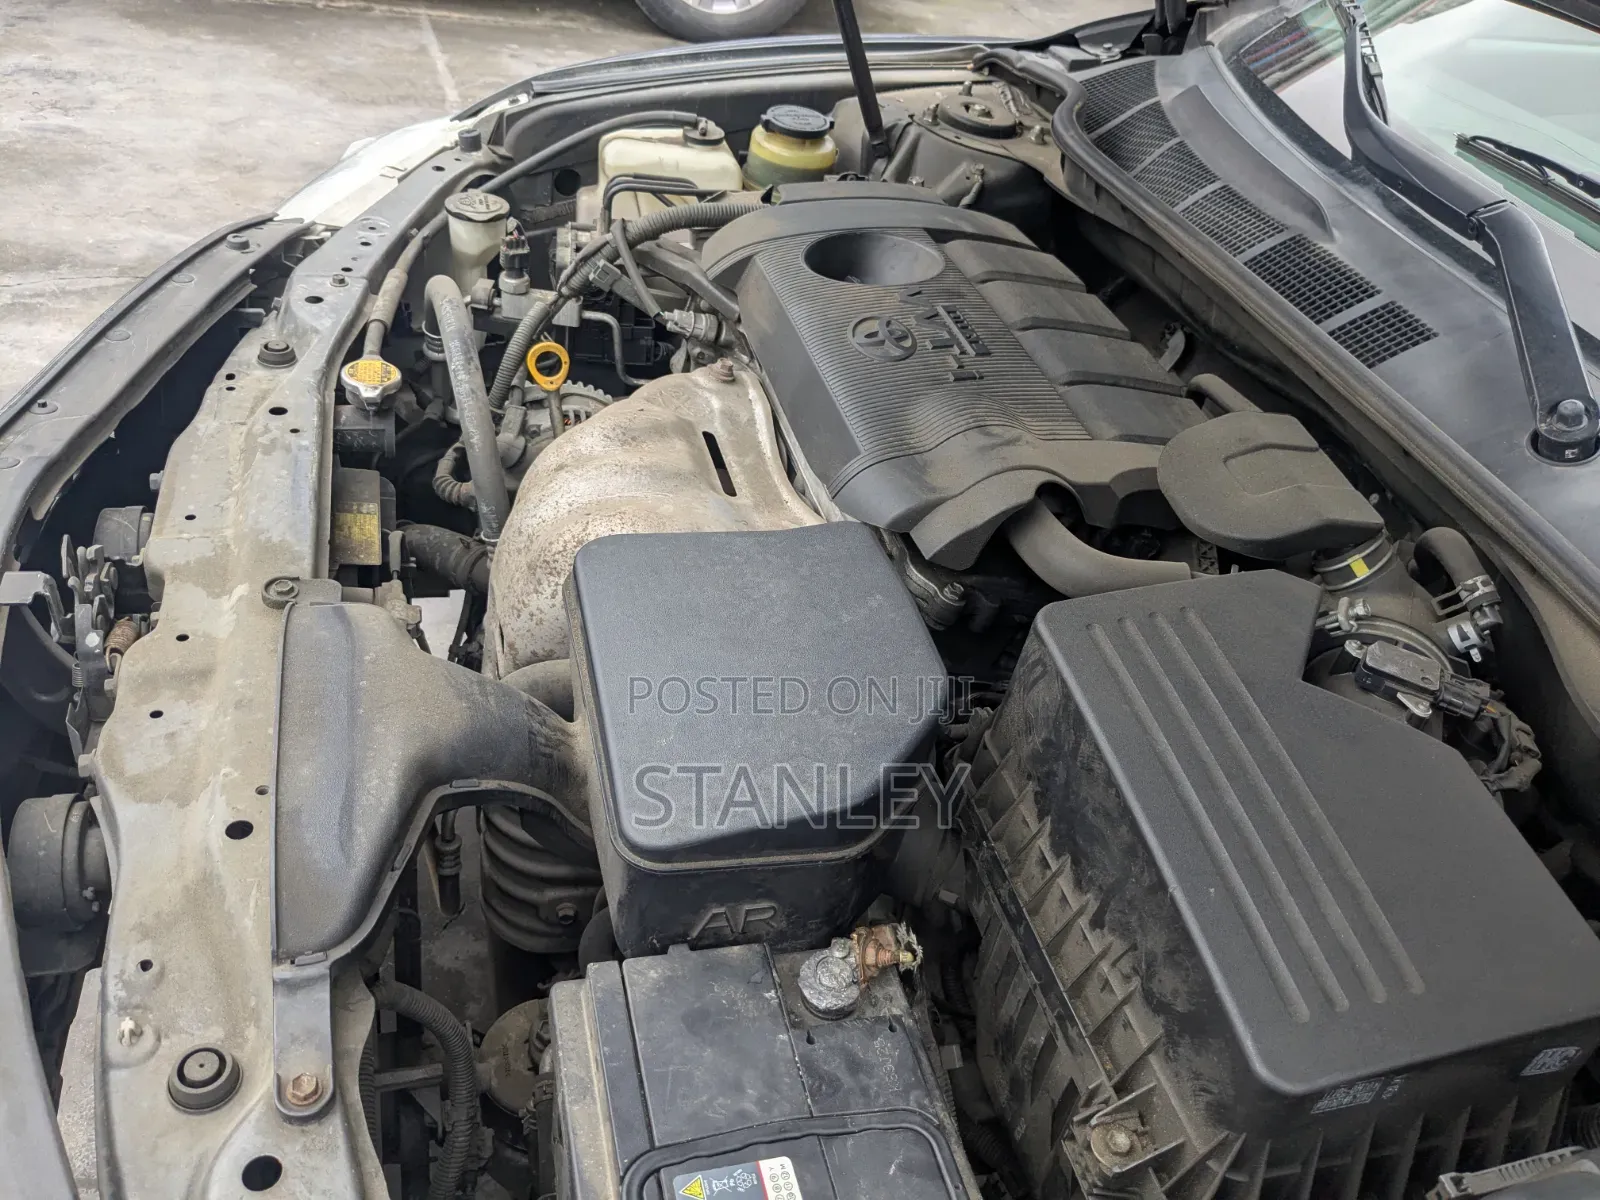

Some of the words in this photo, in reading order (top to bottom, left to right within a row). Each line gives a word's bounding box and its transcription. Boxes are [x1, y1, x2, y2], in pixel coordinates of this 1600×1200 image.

[895, 284, 985, 382] VVT-i
[940, 304, 993, 355] DUAL
[687, 902, 778, 940] AR
